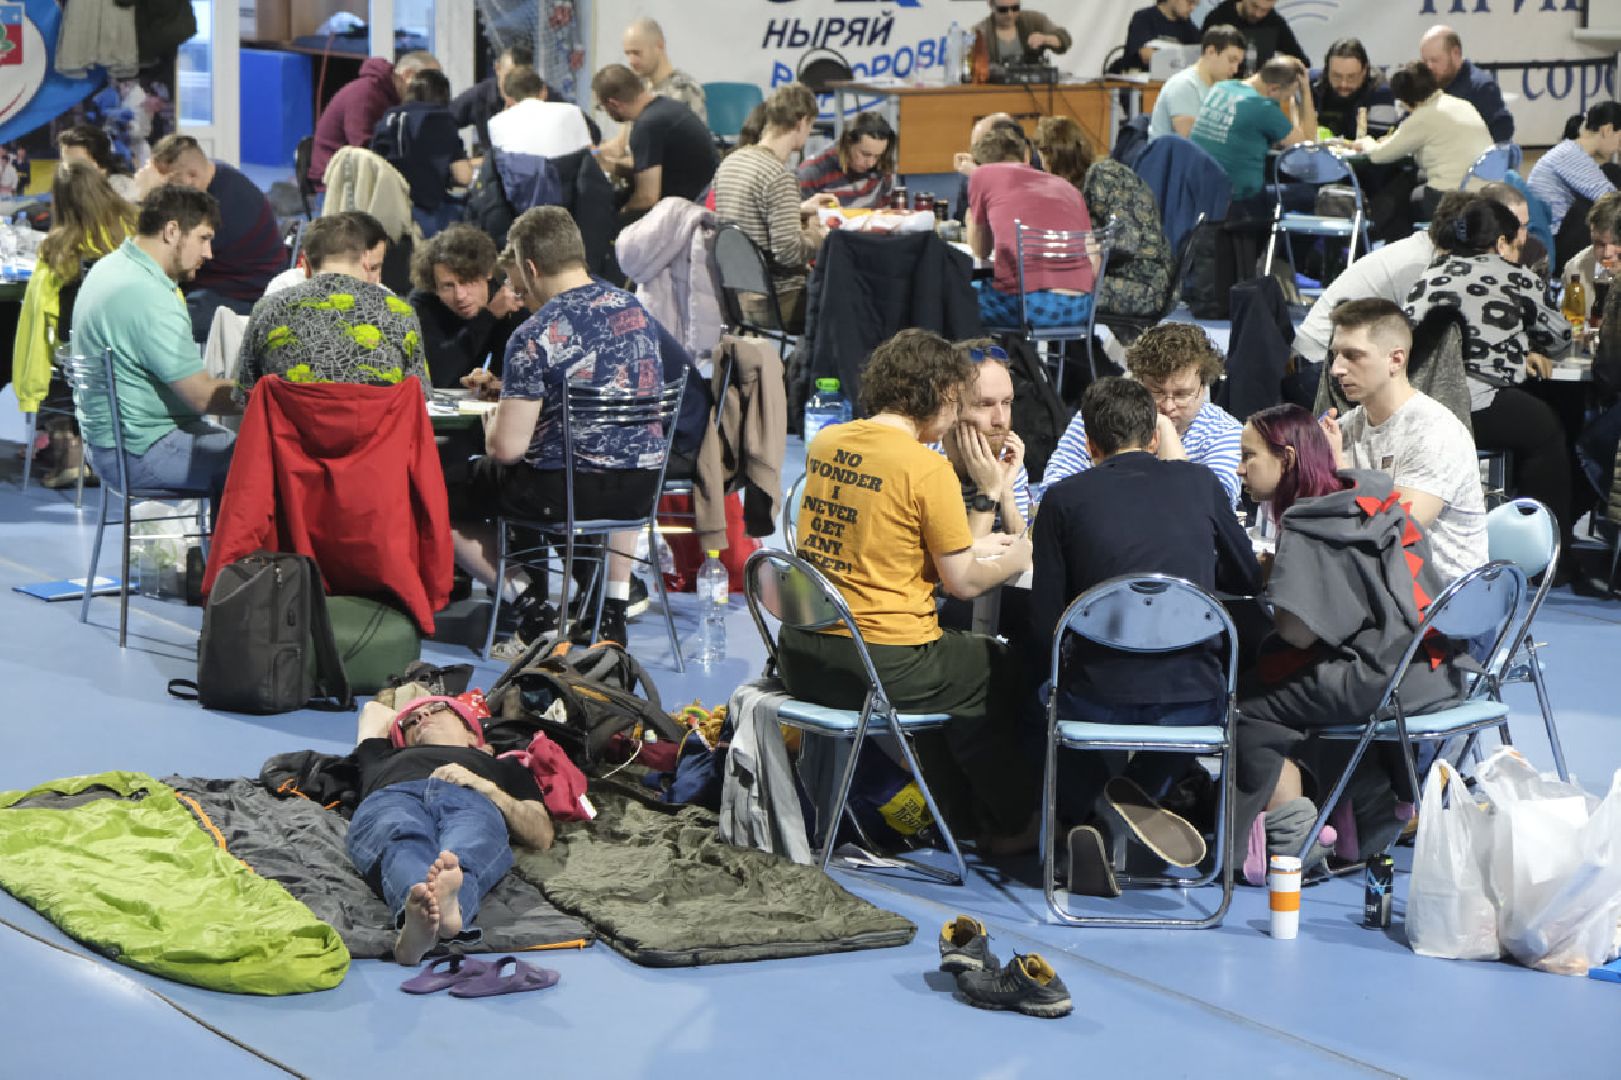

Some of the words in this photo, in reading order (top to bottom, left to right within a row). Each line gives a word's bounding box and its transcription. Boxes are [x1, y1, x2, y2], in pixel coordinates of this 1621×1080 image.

[762, 10, 895, 49] НЫРЯЙ
[834, 449, 862, 467] NO
[832, 486, 840, 498] I
[803, 496, 857, 524] NEVER
[811, 517, 845, 538] GET
[804, 534, 842, 555] ANY
